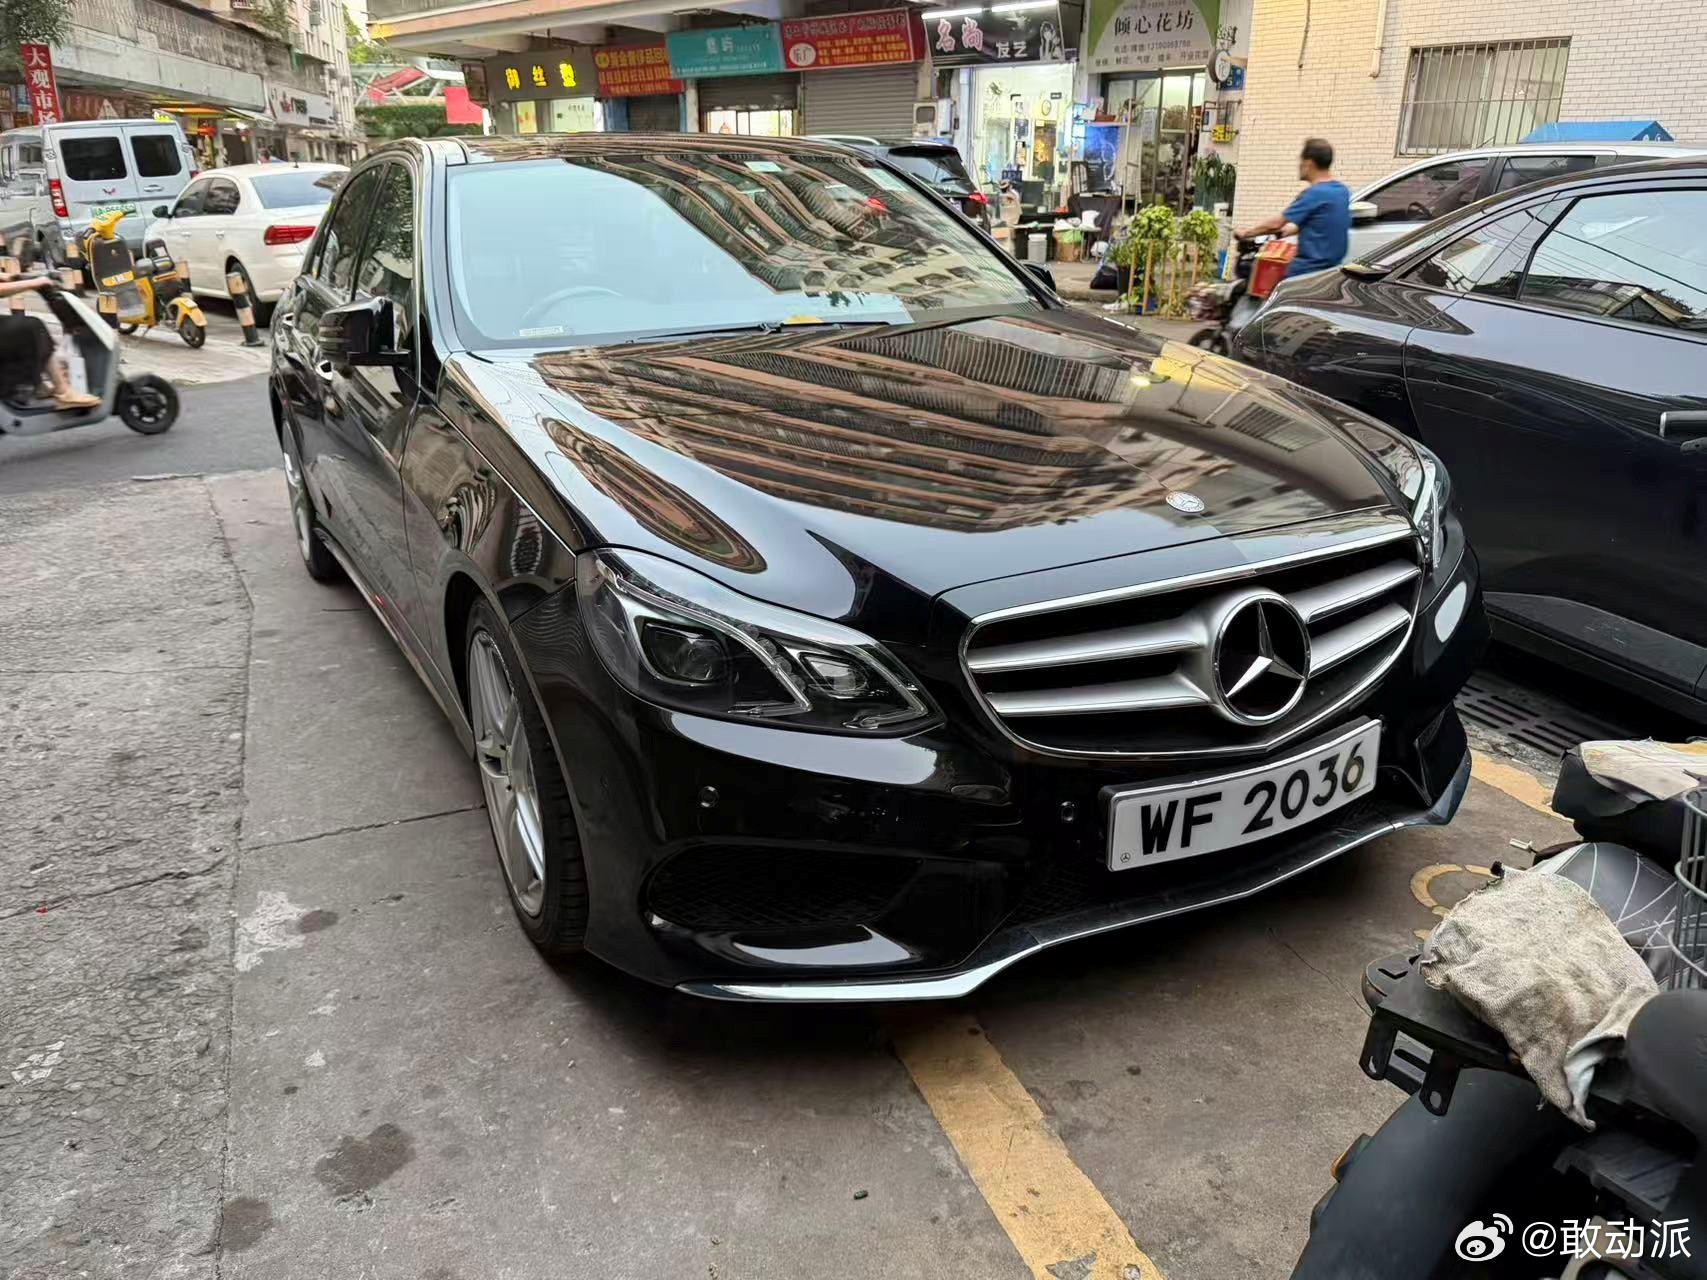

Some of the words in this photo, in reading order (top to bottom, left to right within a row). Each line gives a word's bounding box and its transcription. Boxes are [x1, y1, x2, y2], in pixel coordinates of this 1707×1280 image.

[1114, 10, 1194, 36] 倾心花坊
[1141, 792, 1223, 856] WF
[1241, 742, 1365, 835] 2036
